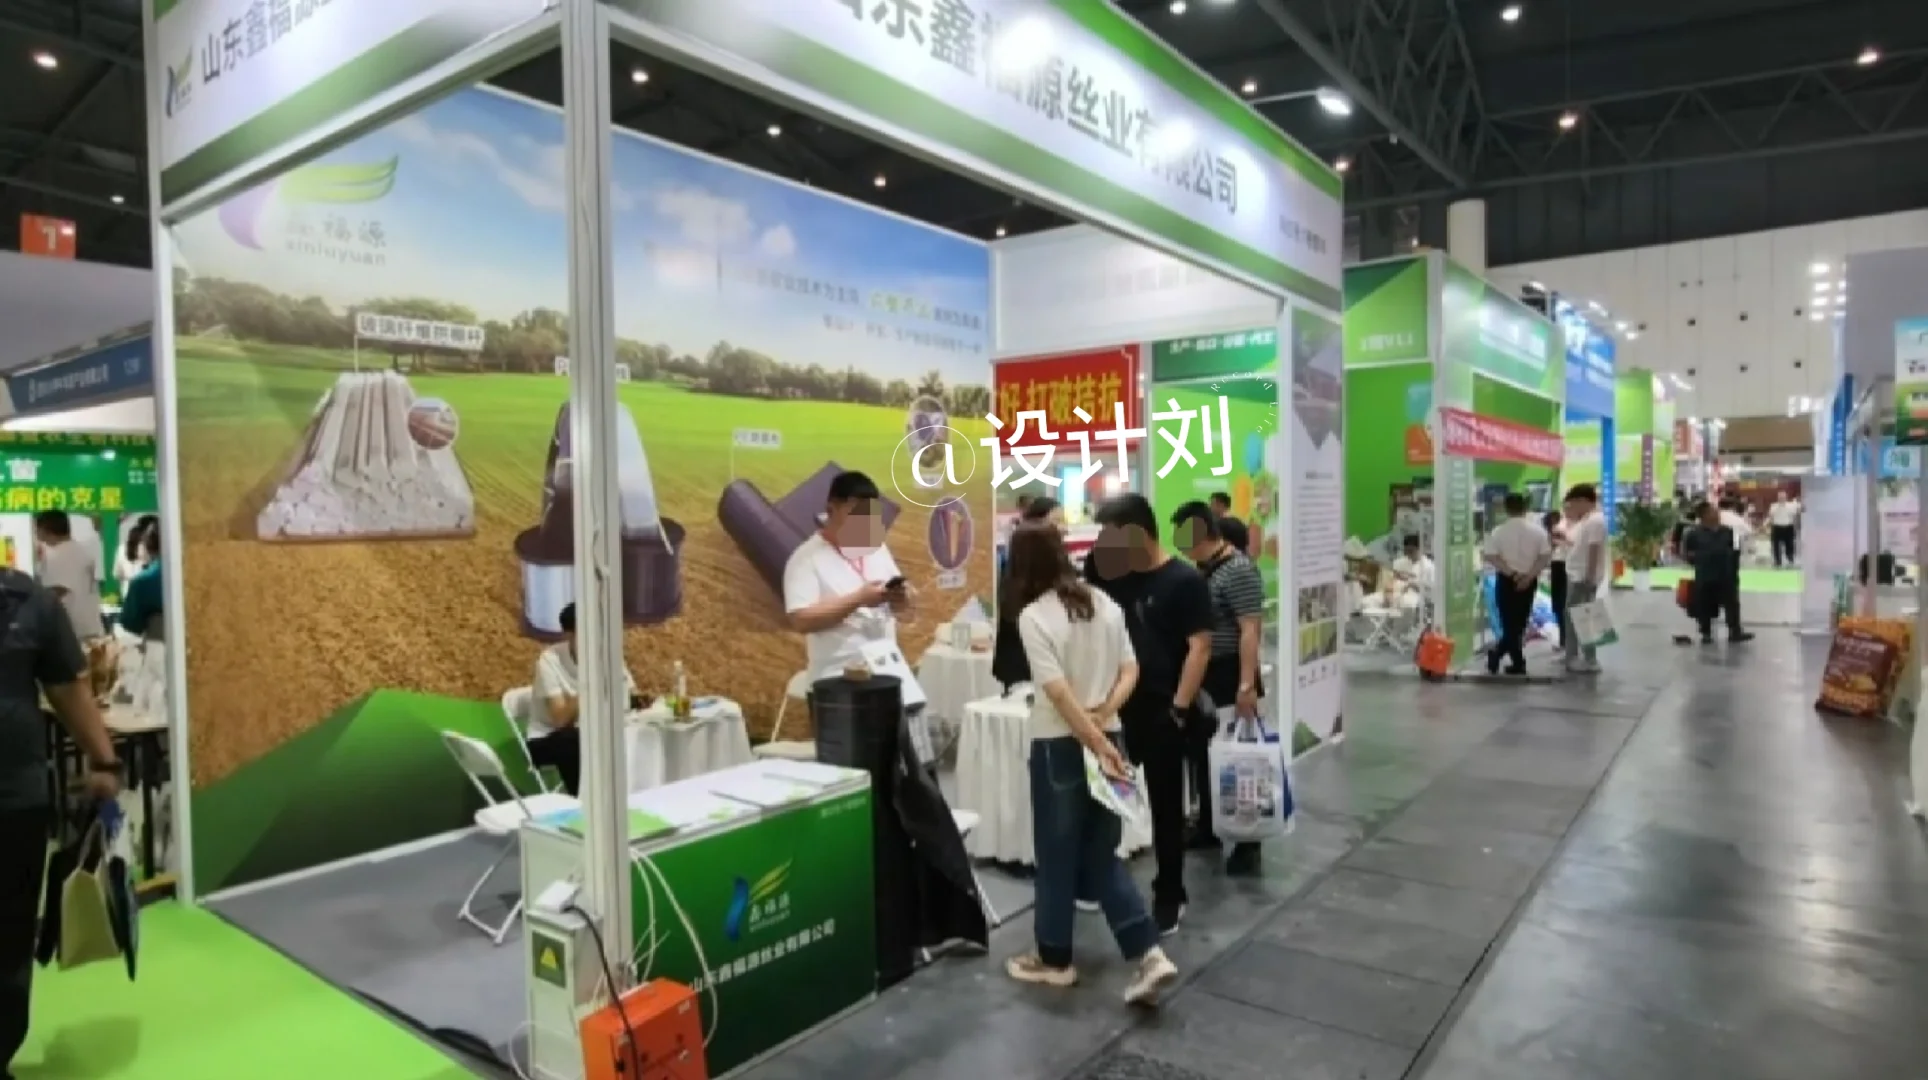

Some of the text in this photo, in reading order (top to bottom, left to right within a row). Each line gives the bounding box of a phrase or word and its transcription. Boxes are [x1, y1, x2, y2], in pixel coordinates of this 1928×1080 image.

[285, 210, 387, 249] 福源
[0, 485, 125, 511] 病的克星
